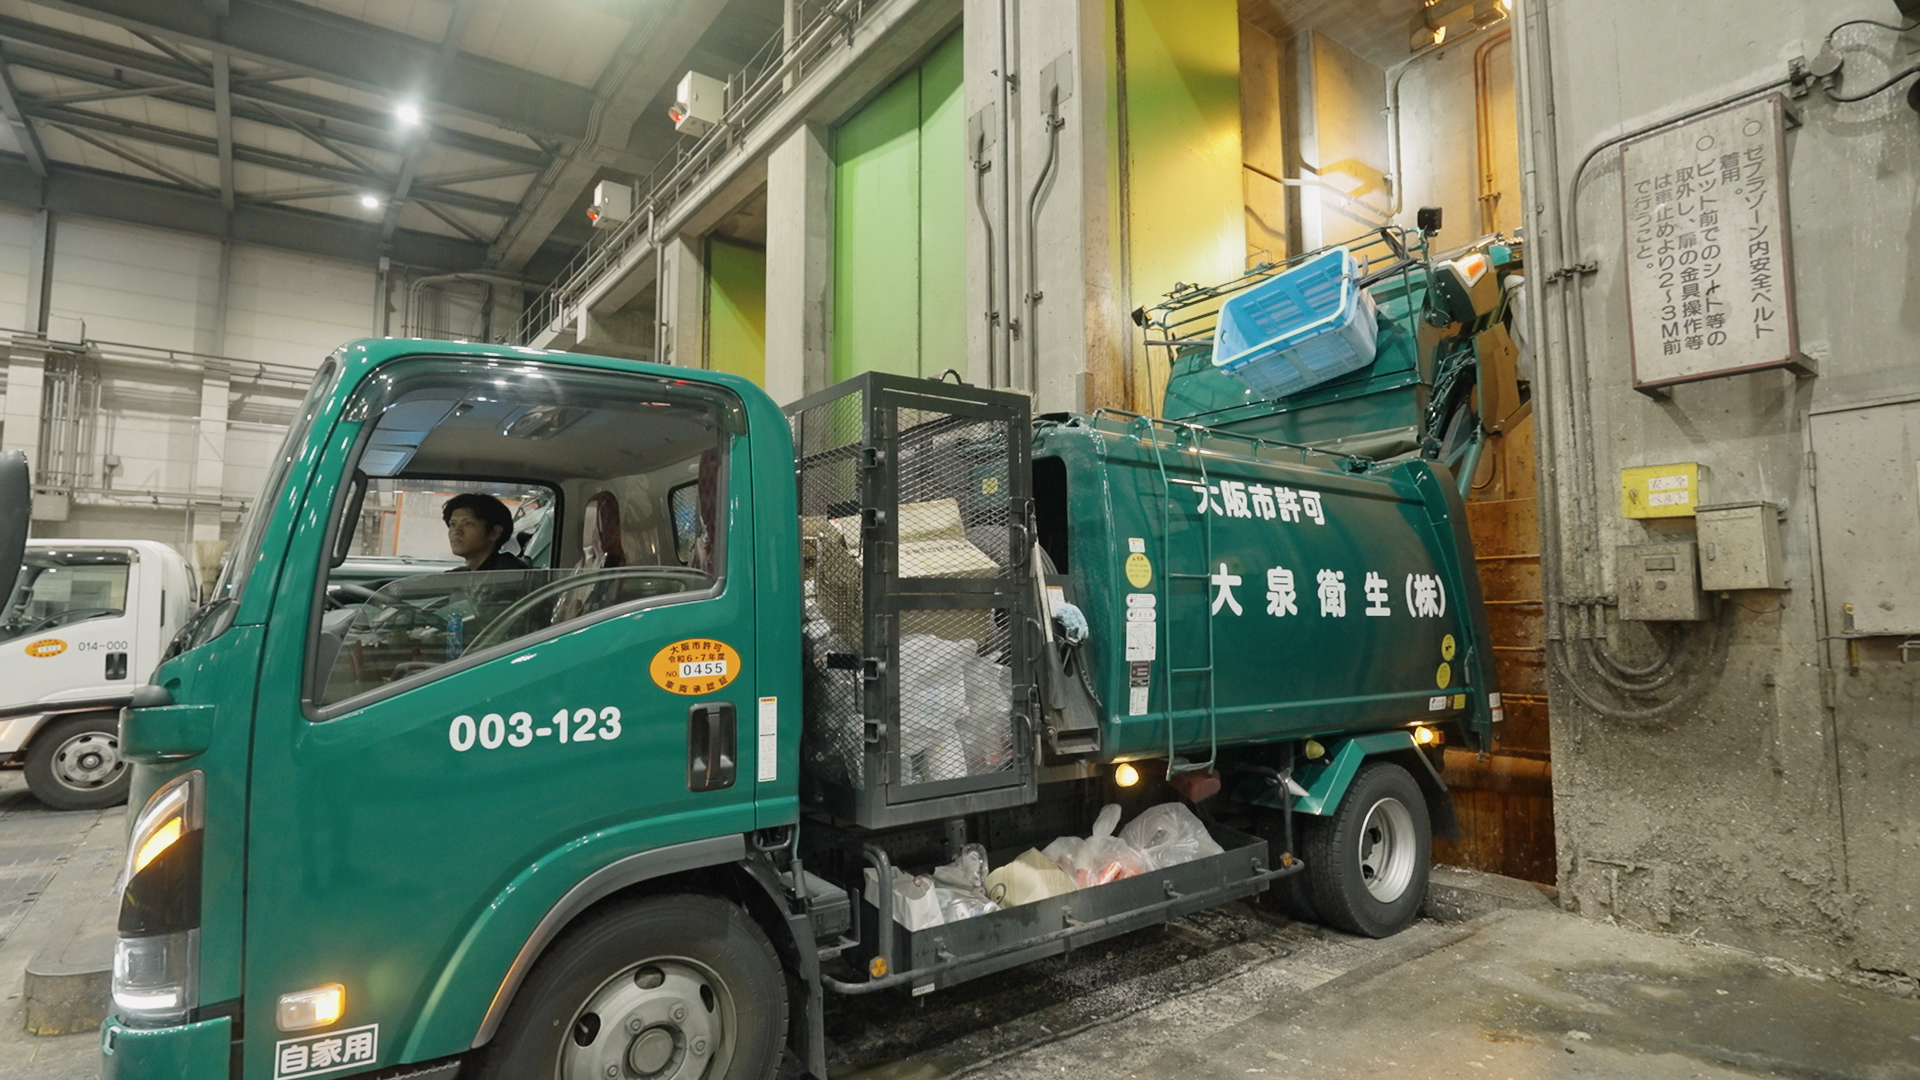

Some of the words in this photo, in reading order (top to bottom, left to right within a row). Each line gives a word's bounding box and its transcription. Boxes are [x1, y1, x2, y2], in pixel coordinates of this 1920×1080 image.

[1192, 480, 1325, 525] 大阪市許可
[78, 641, 128, 651] 014-000
[669, 641, 723, 655] 大阪市許可
[683, 662, 724, 676] 0455
[449, 706, 622, 751] 003-123
[280, 1032, 373, 1074] 自家用
